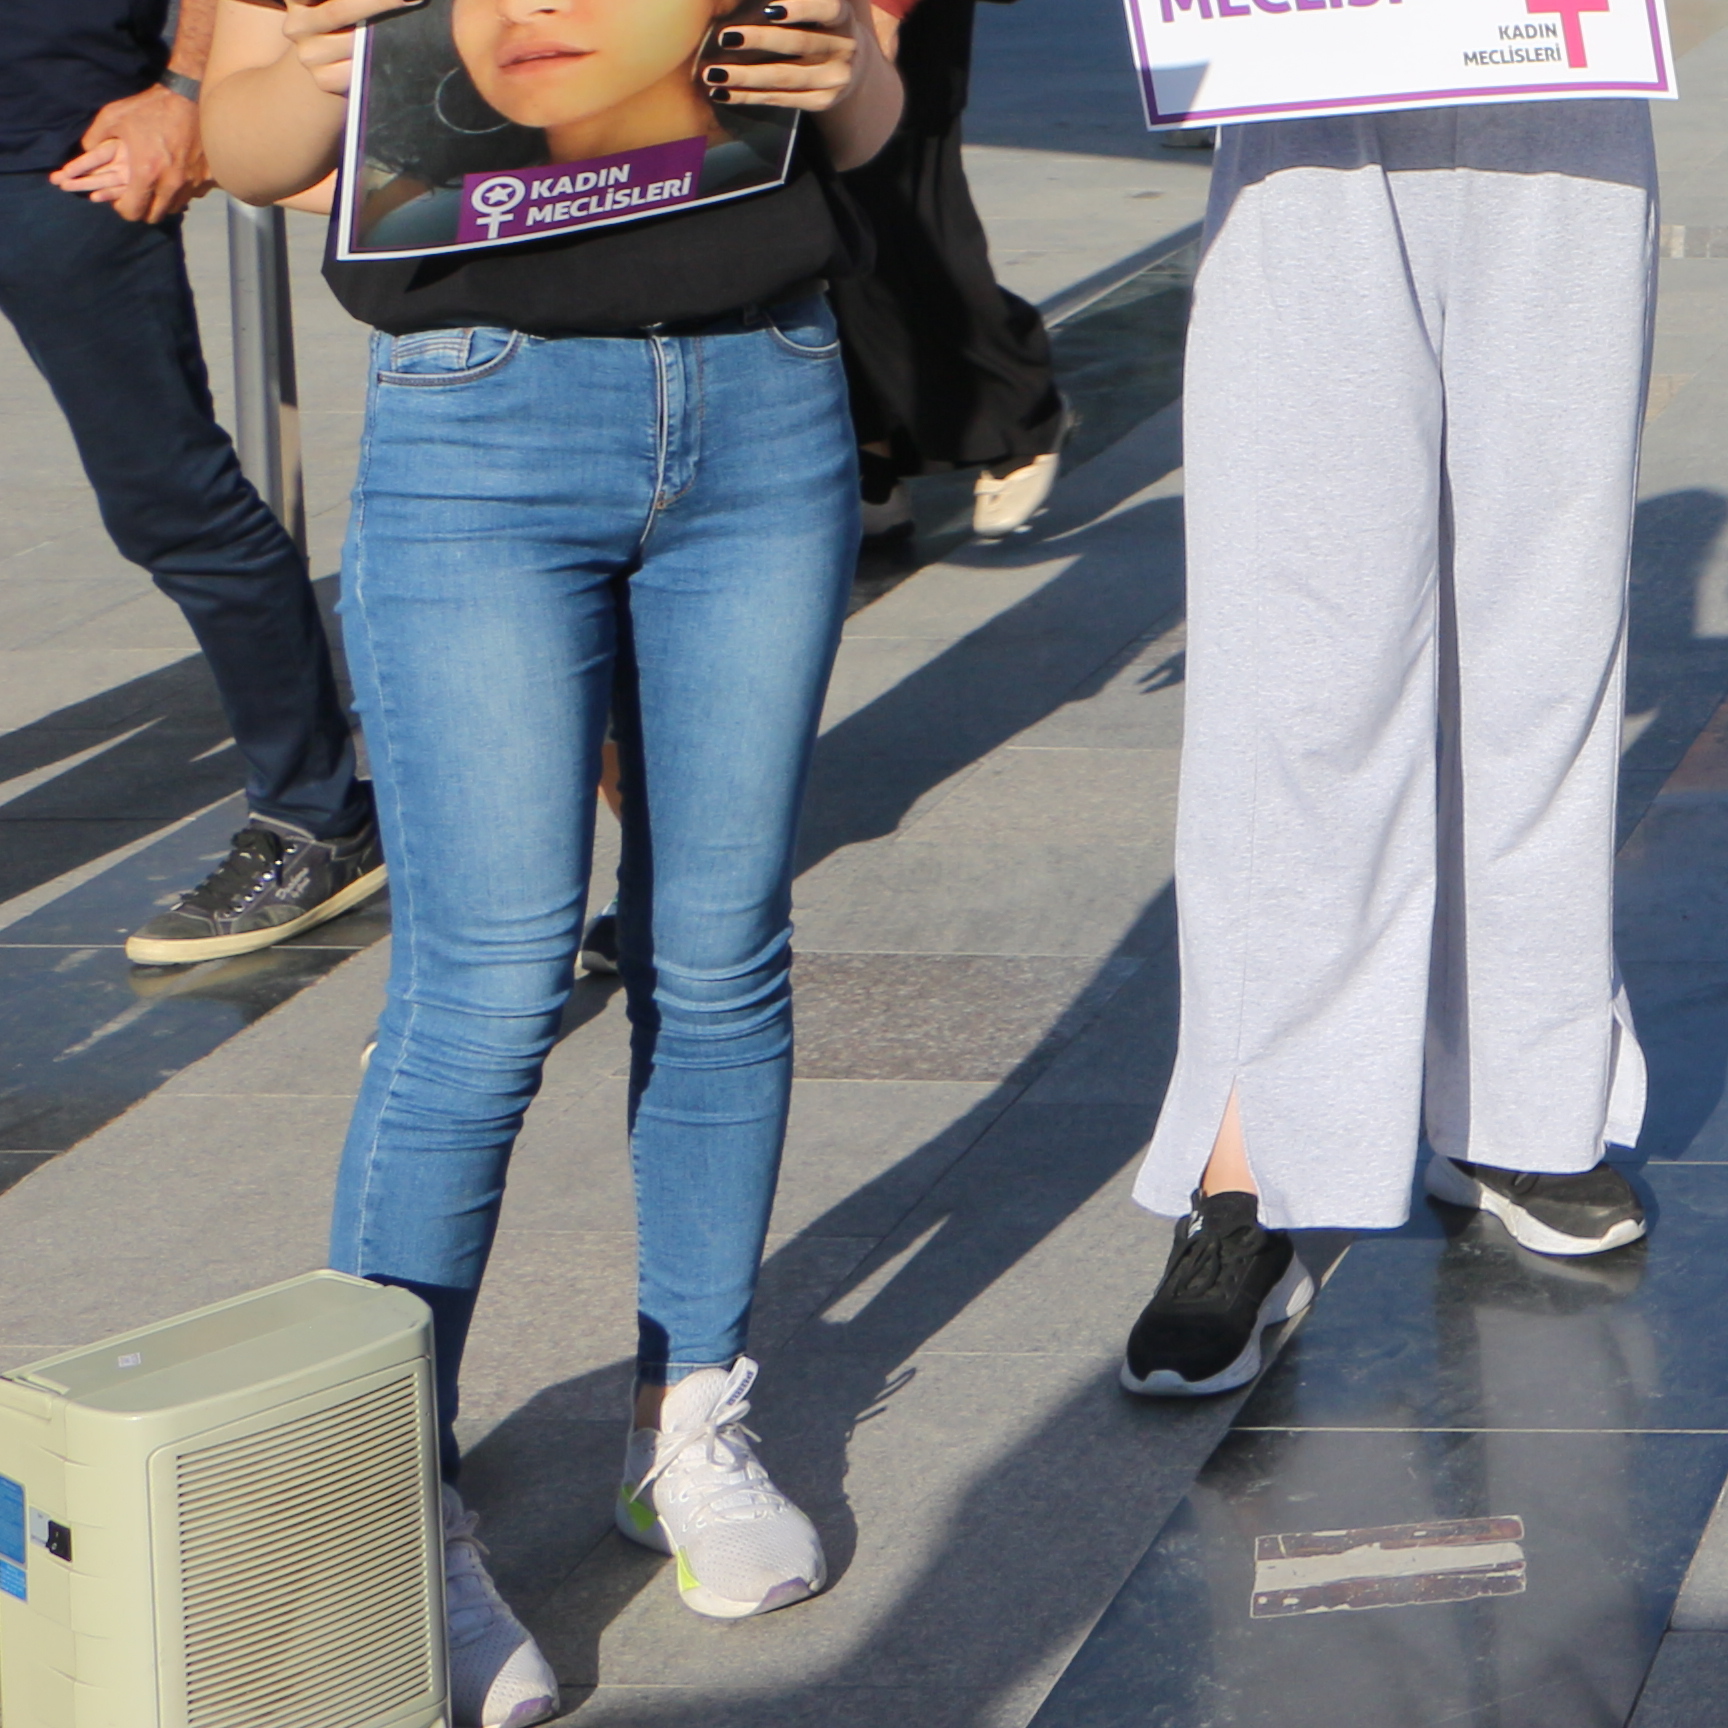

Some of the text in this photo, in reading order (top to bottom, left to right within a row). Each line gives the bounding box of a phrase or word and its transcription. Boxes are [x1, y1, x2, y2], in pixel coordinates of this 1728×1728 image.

[1498, 22, 1559, 41] KADIN
[1463, 42, 1562, 67] MECLİSLERİ
[529, 162, 631, 201] KADIN
[525, 170, 694, 227] MECLİSLERİ
